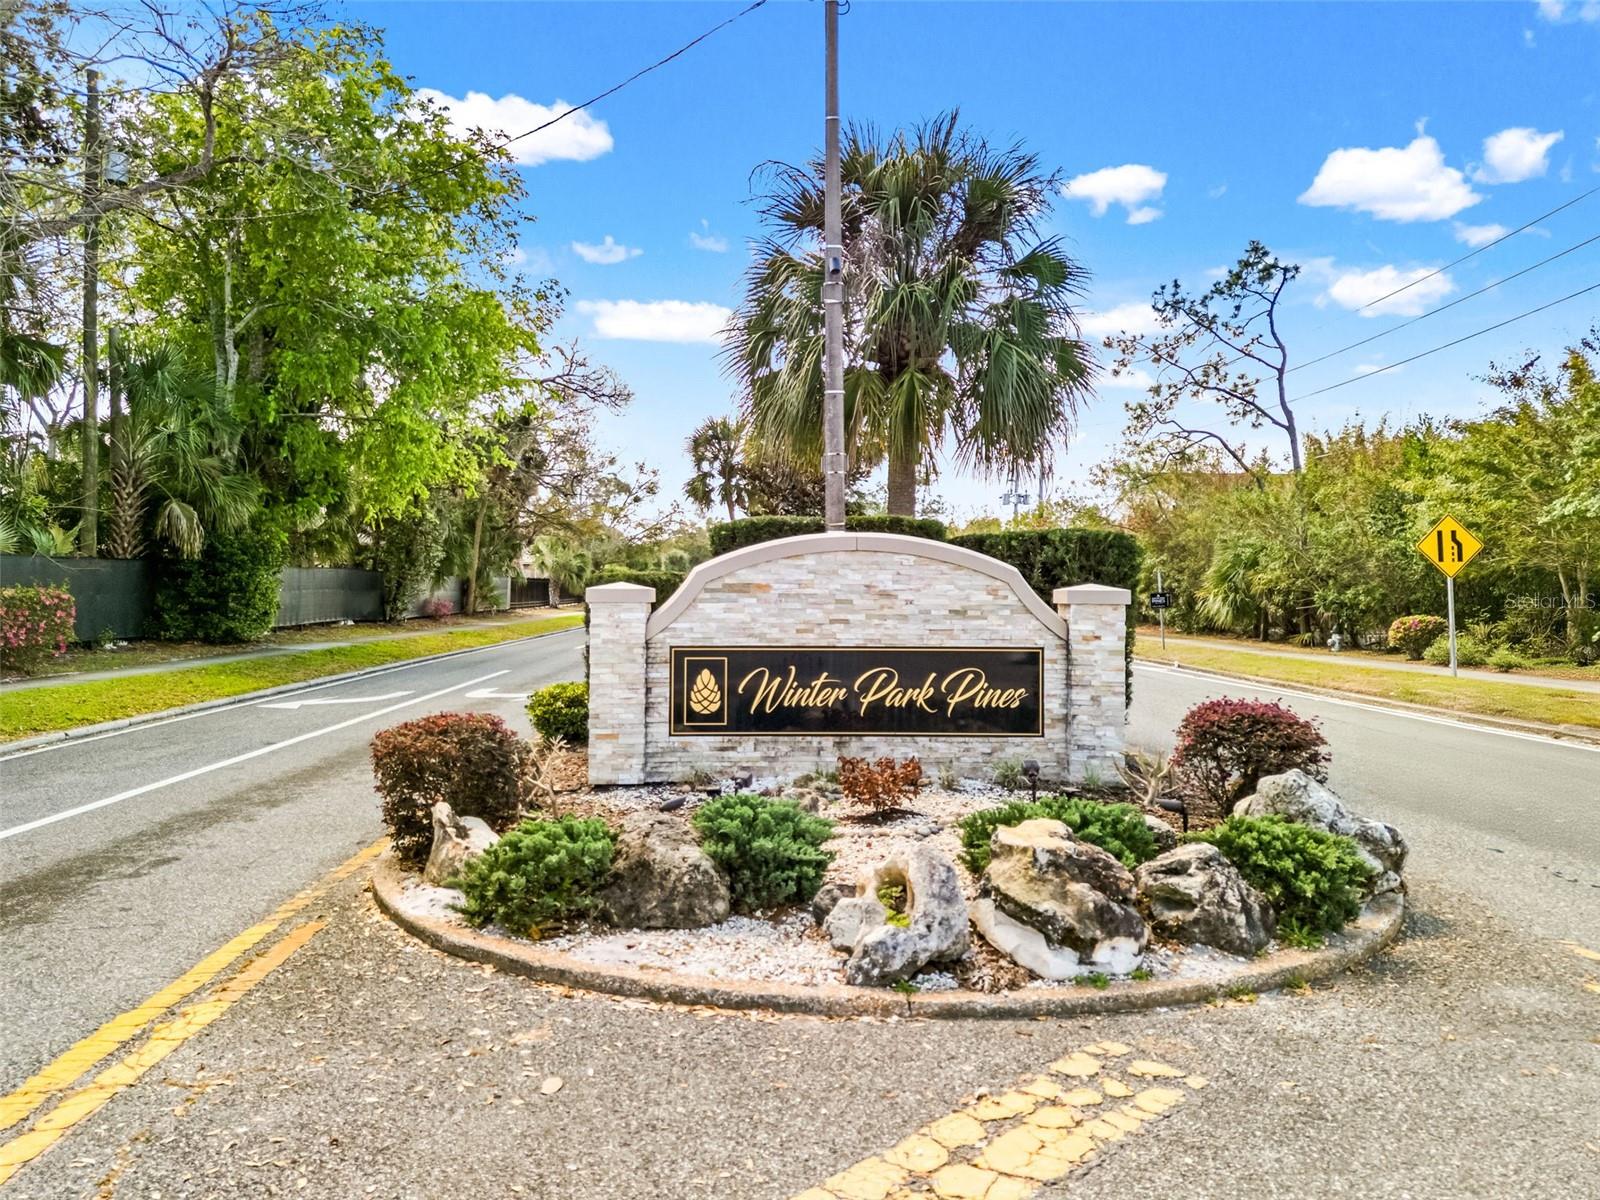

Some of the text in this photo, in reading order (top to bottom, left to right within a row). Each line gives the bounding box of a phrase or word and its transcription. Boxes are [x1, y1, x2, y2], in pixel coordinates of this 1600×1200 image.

[738, 665, 1029, 717] Winter Park Pines
